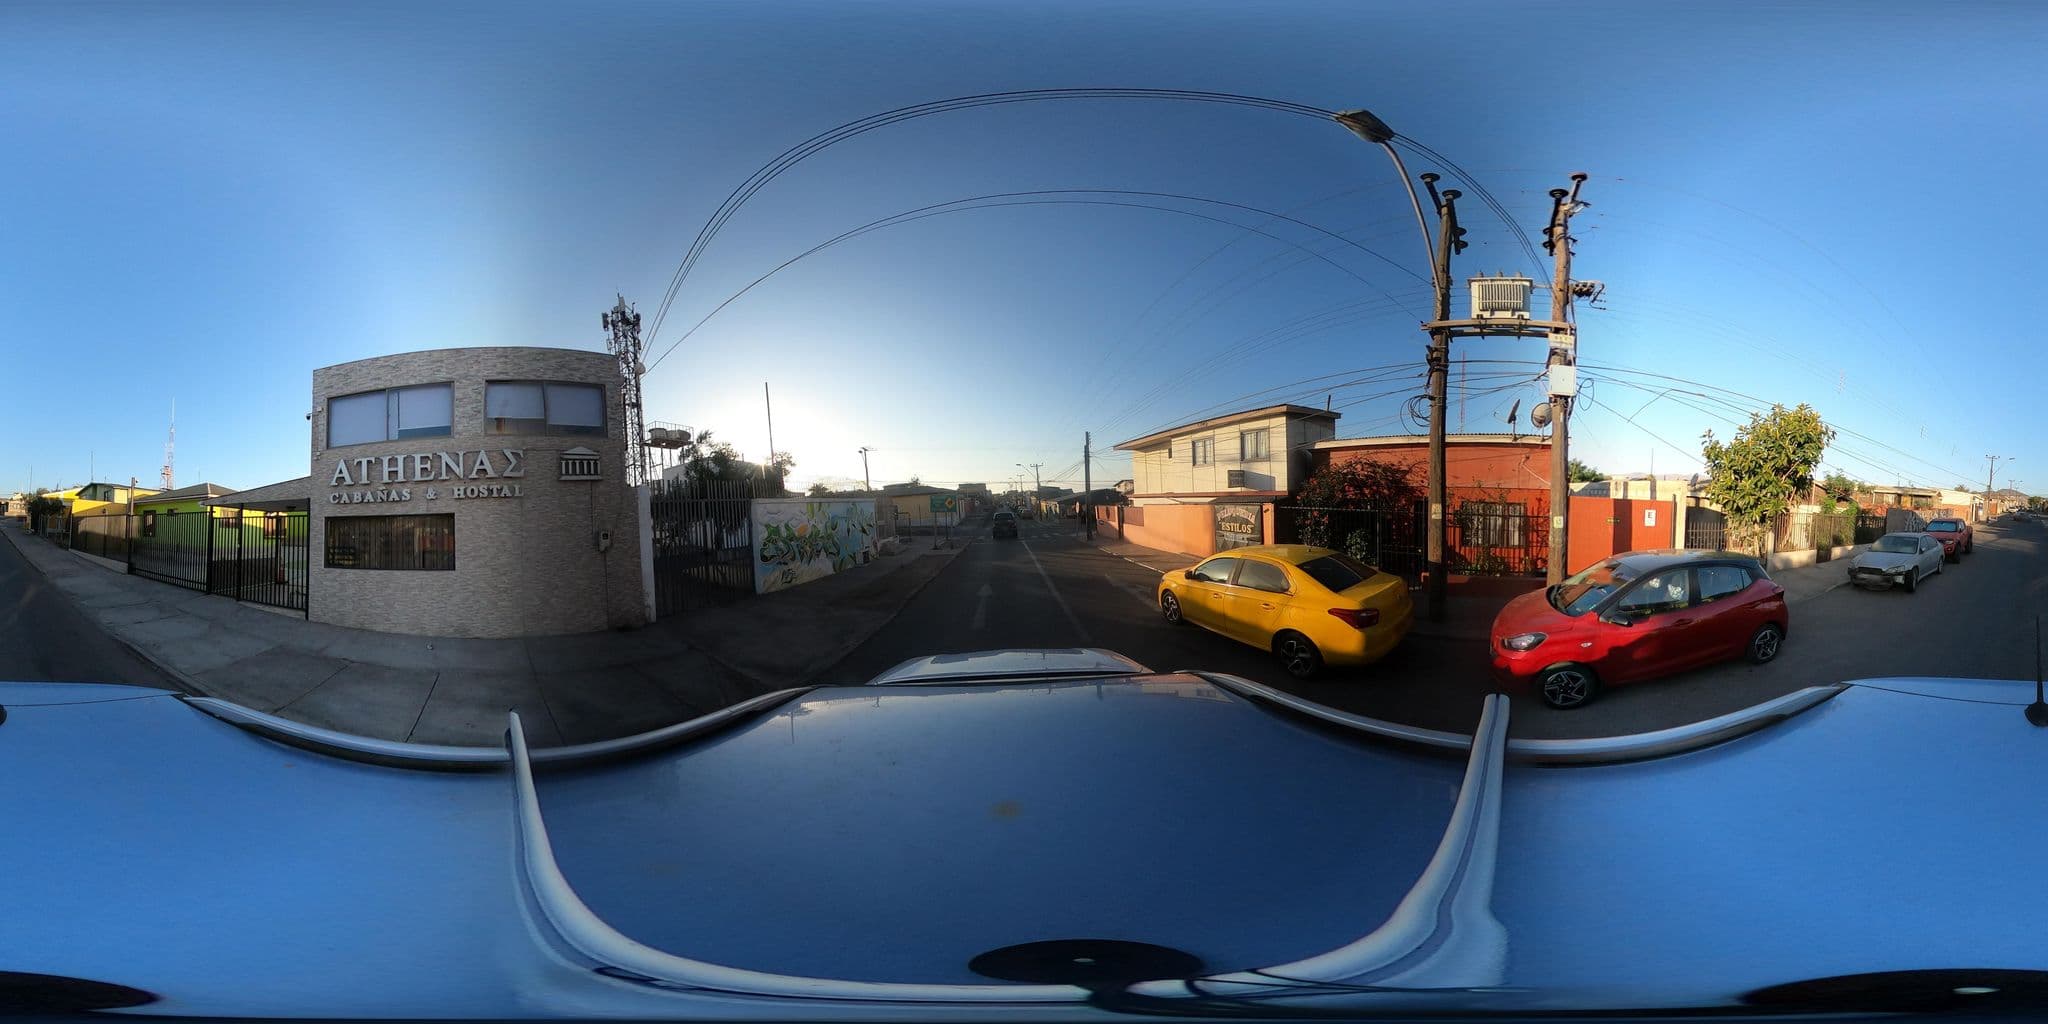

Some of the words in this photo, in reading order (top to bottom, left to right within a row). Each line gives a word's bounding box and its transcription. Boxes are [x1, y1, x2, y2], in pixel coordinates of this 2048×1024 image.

[330, 486, 411, 504] CABAÑAS
[426, 487, 437, 500] &
[454, 484, 524, 499] HOSTAL
